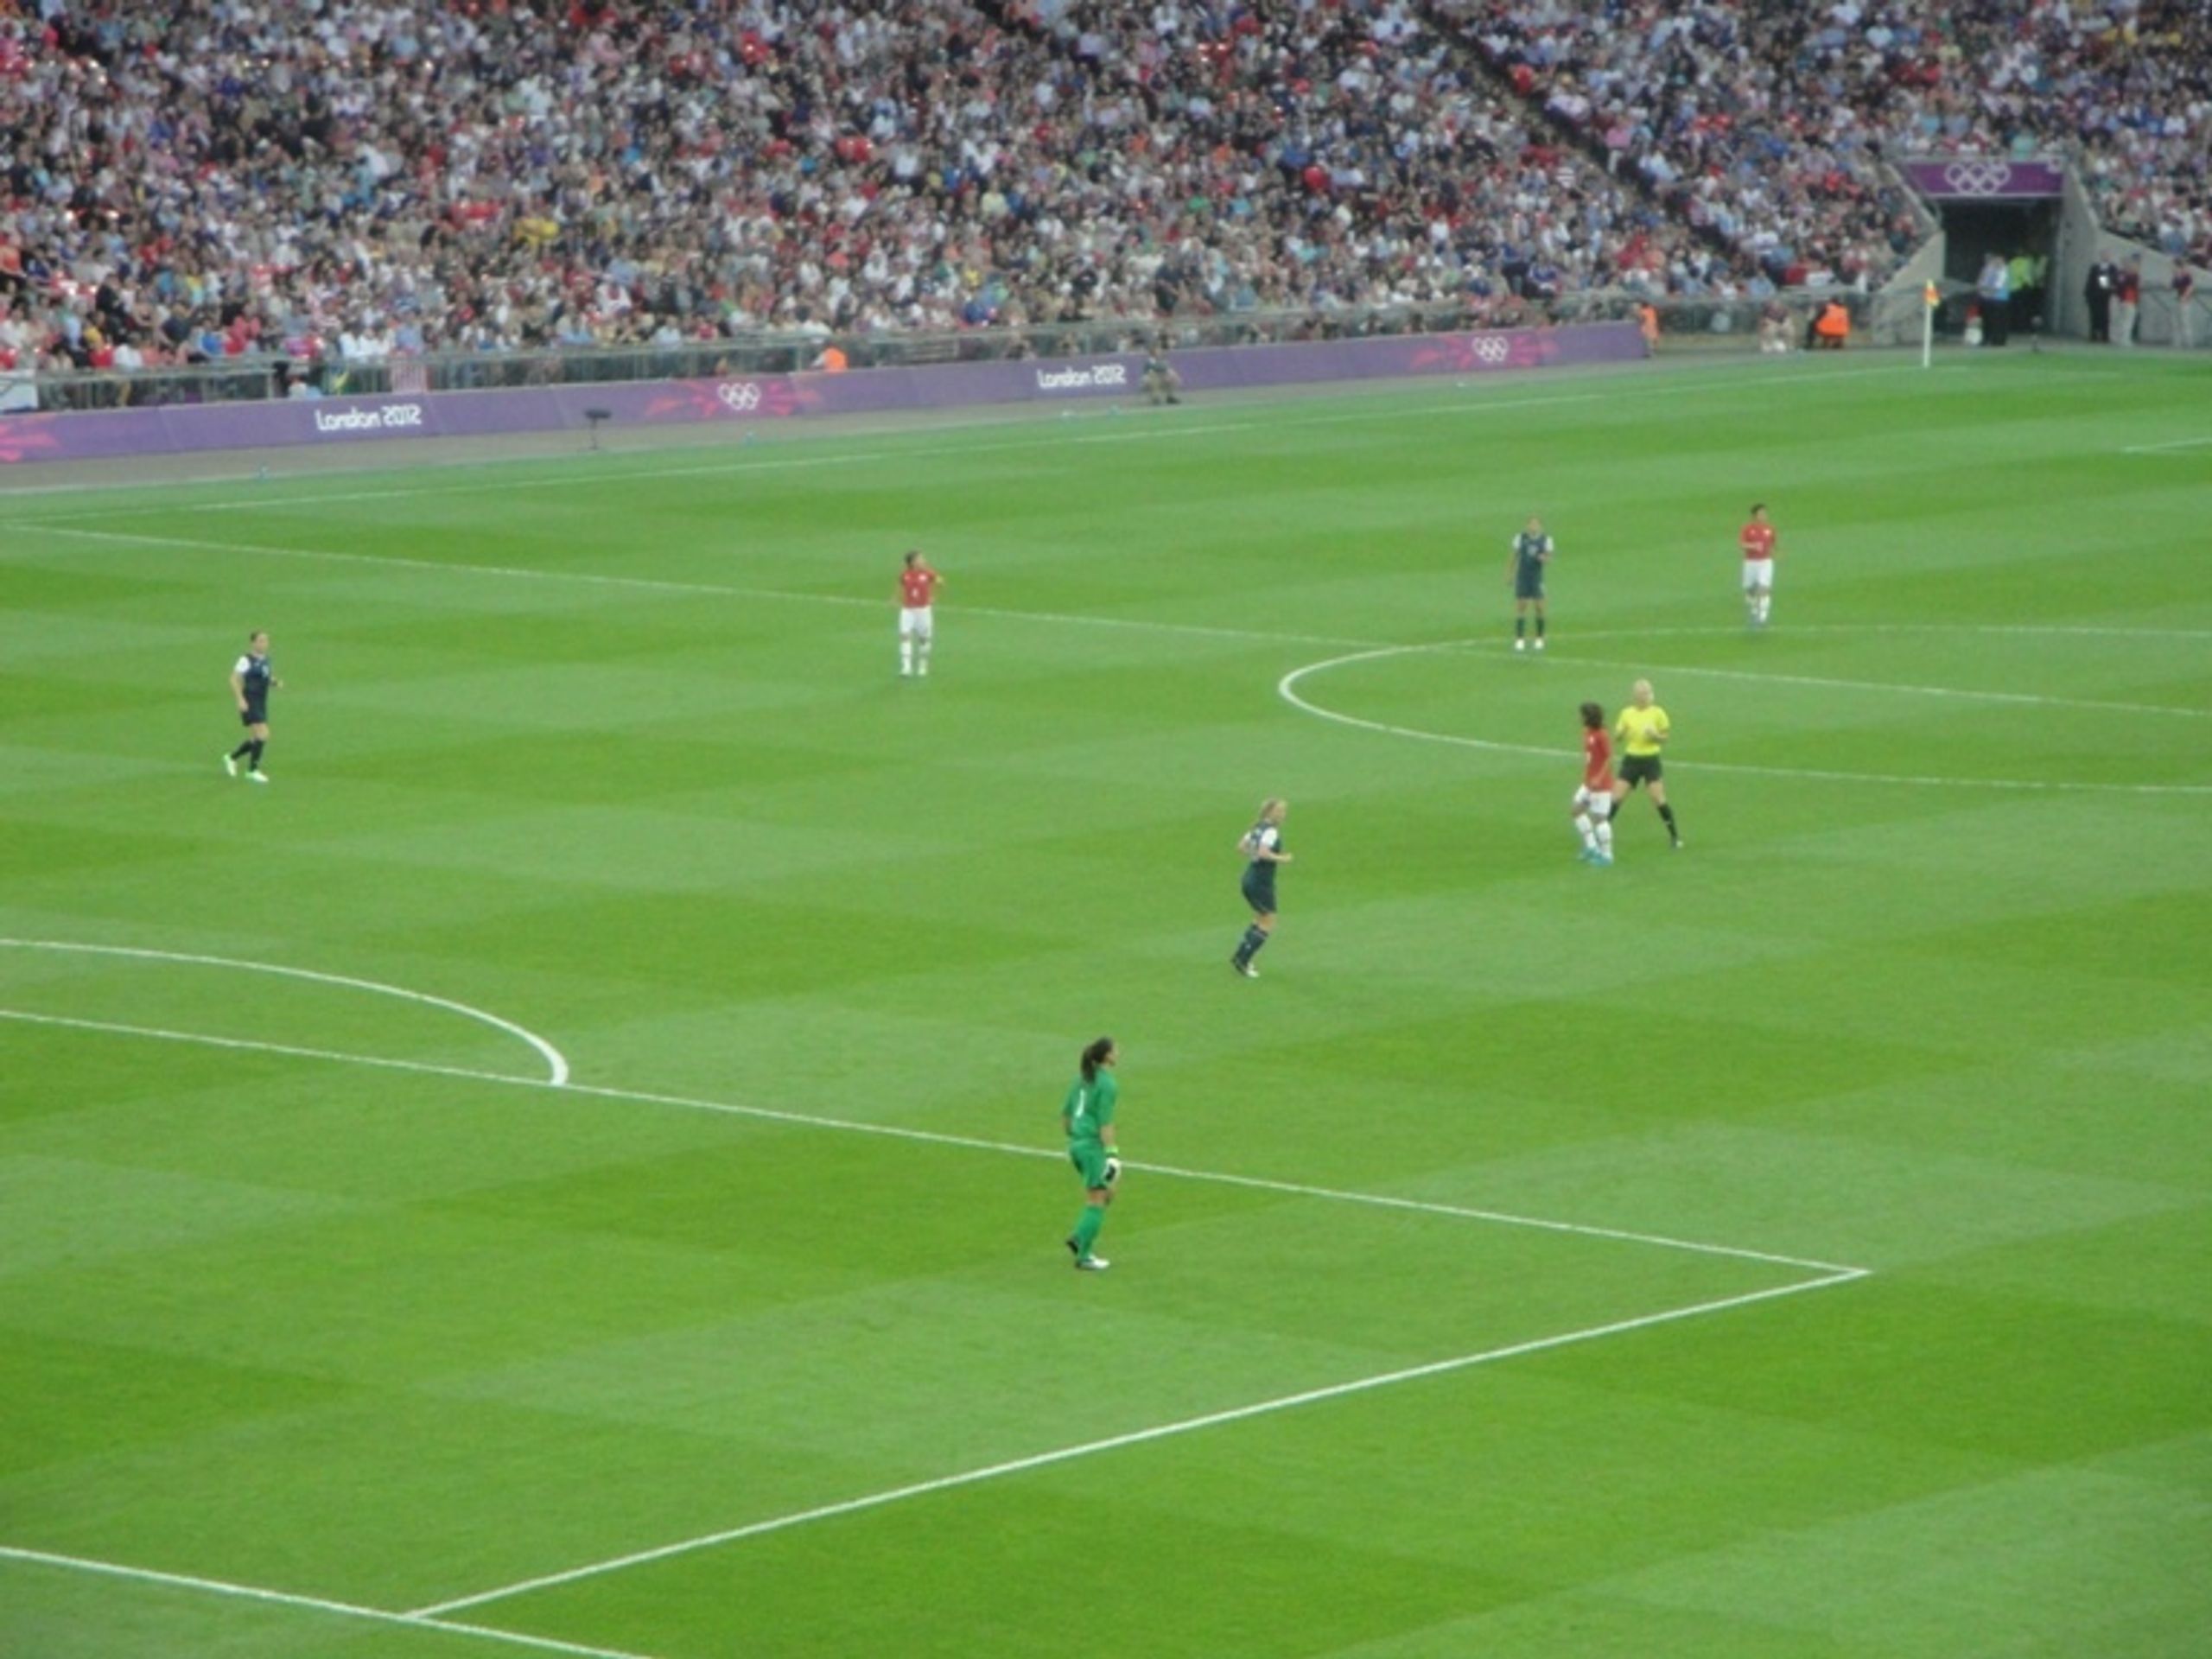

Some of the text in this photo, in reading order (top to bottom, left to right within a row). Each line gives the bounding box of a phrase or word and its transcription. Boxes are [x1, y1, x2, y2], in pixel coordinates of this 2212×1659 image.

[1037, 364, 1127, 389] London 2012
[315, 404, 422, 431] London 2012
